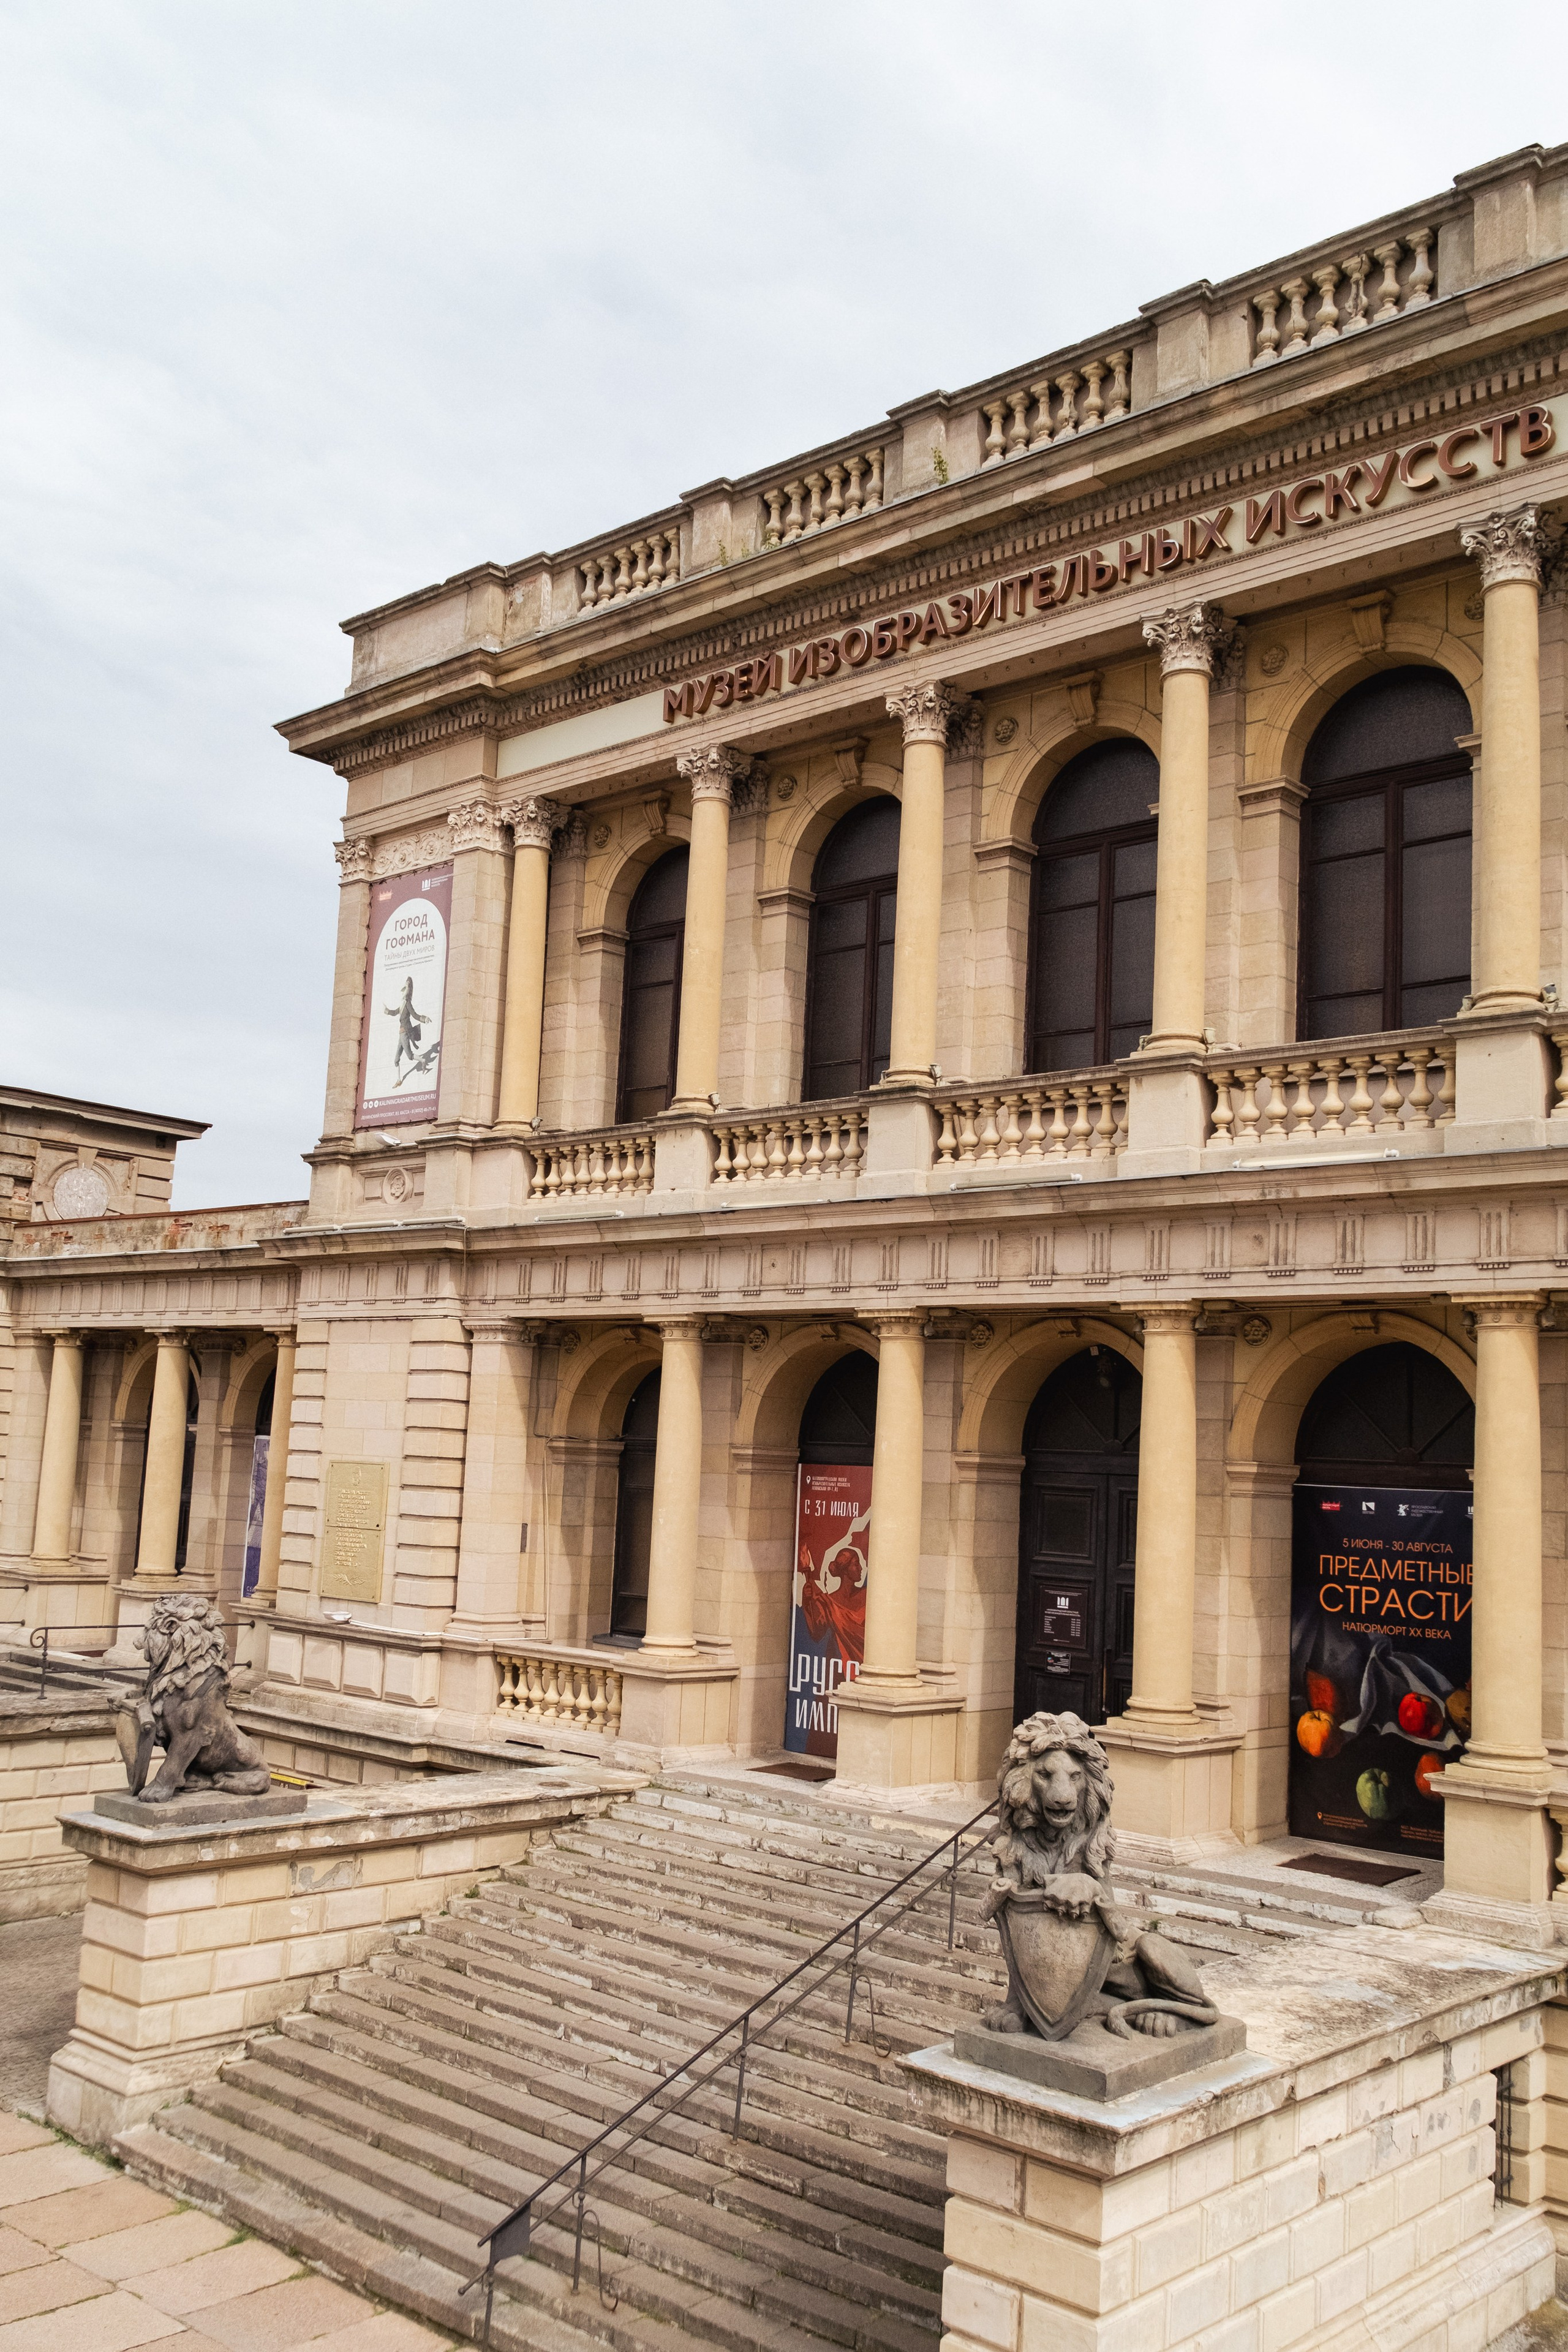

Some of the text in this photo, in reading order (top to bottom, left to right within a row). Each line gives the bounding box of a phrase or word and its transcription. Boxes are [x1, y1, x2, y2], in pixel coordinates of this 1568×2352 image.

[663, 404, 1556, 723] МУЗЕЙ ИЗОБРАЗИТЕЛЬНЫХ ИСКУССТВ
[395, 914, 428, 932] ГОРОД
[386, 929, 435, 949] ГОФМАНА
[384, 952, 402, 961] ТАЙНЫ
[402, 949, 416, 959] ДВУХ
[417, 944, 435, 954] МИРОВ
[804, 1499, 859, 1517] С 31 ИЮЛЯ
[1342, 1538, 1349, 1548] 5
[1351, 1539, 1383, 1550] ИЮНЯ
[1392, 1541, 1404, 1551] 30
[1406, 1542, 1453, 1554] АВГУСТА
[1342, 1622, 1407, 1636] НАТЮРМОРТ
[1425, 1629, 1452, 1640] ВЕКА
[795, 1698, 838, 1734] ИМП
